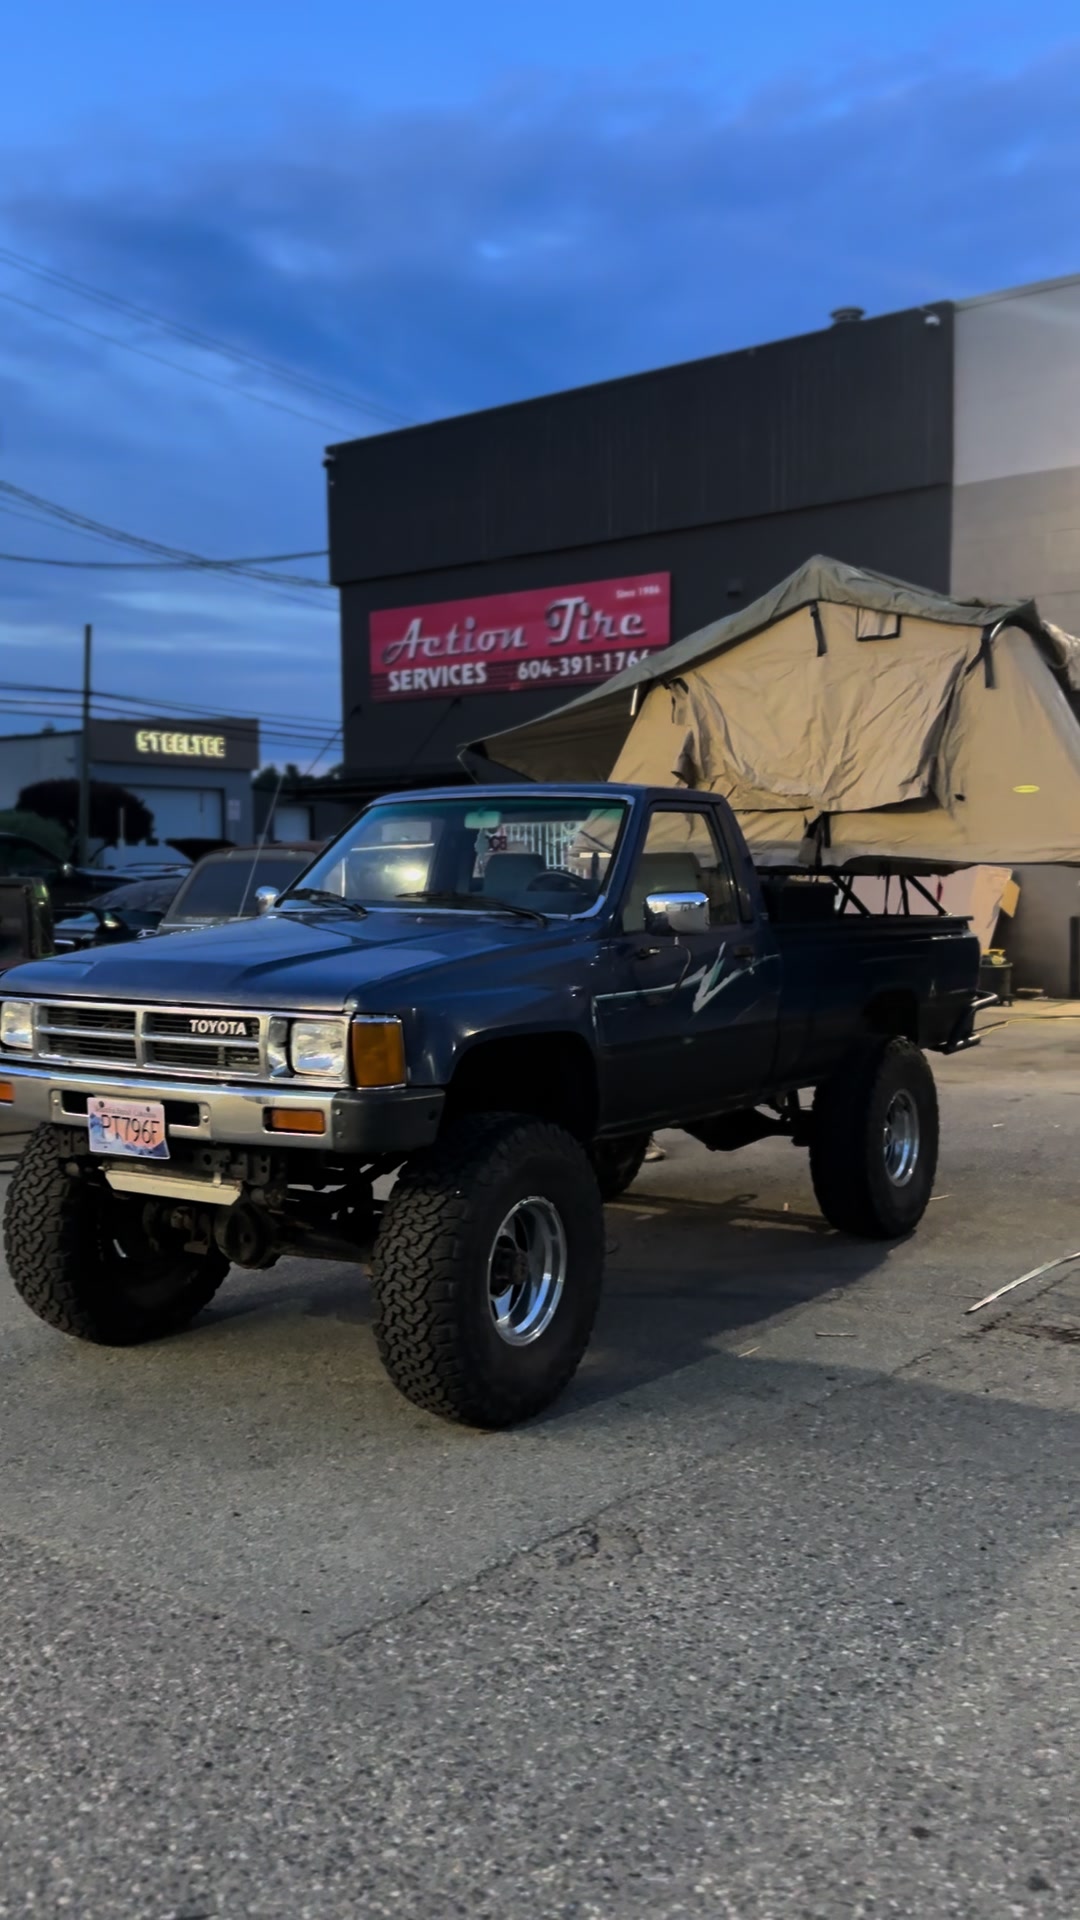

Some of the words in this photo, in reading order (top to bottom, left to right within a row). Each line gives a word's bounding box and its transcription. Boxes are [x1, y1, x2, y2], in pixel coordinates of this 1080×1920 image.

[382, 617, 528, 664] Action
[545, 596, 646, 644] Tire
[388, 661, 488, 692] SERVICES
[189, 1019, 247, 1035] TOYOTA
